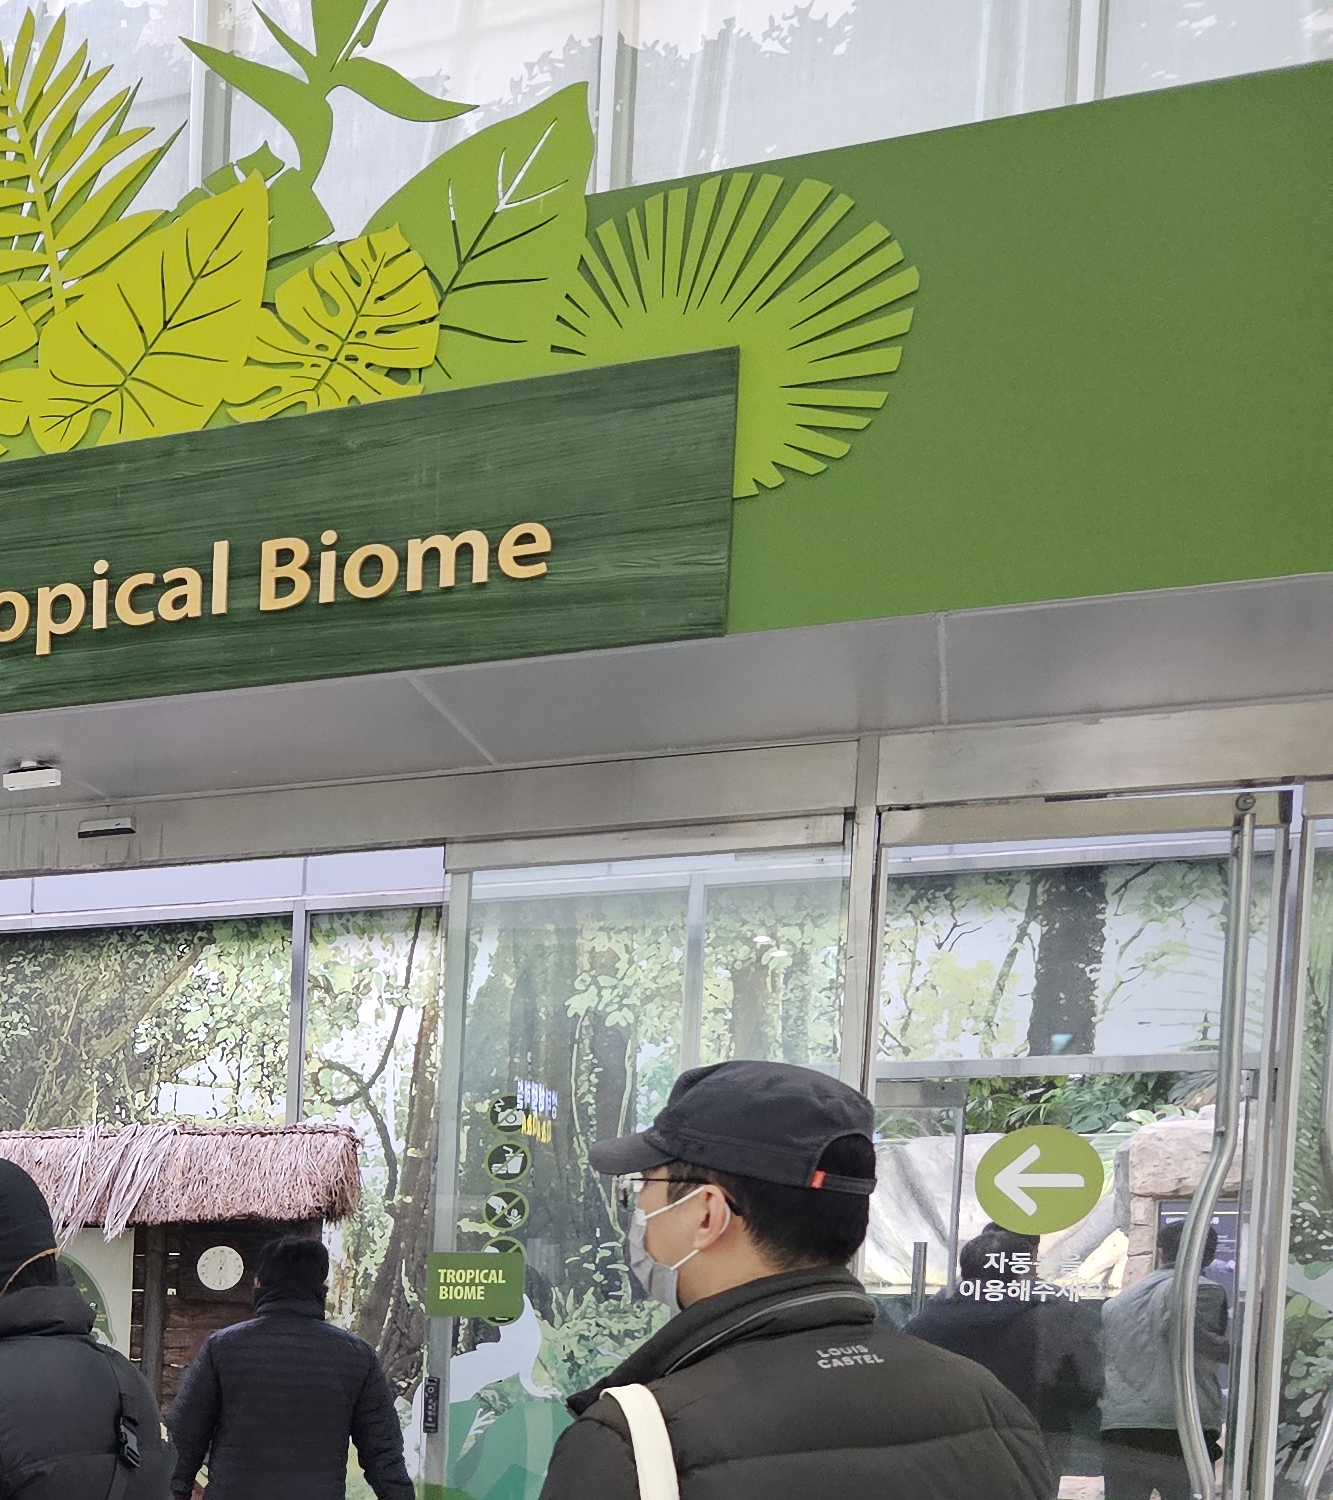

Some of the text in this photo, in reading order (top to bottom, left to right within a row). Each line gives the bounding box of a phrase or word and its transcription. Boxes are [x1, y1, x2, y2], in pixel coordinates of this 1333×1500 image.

[259, 521, 552, 612] Biome
[437, 1268, 507, 1284] TROPICAL
[438, 1285, 485, 1300] BIOME
[958, 1278, 1107, 1303] 이용해주세요
[816, 1344, 869, 1358] LOUIS
[817, 1353, 885, 1369] CASTEL
